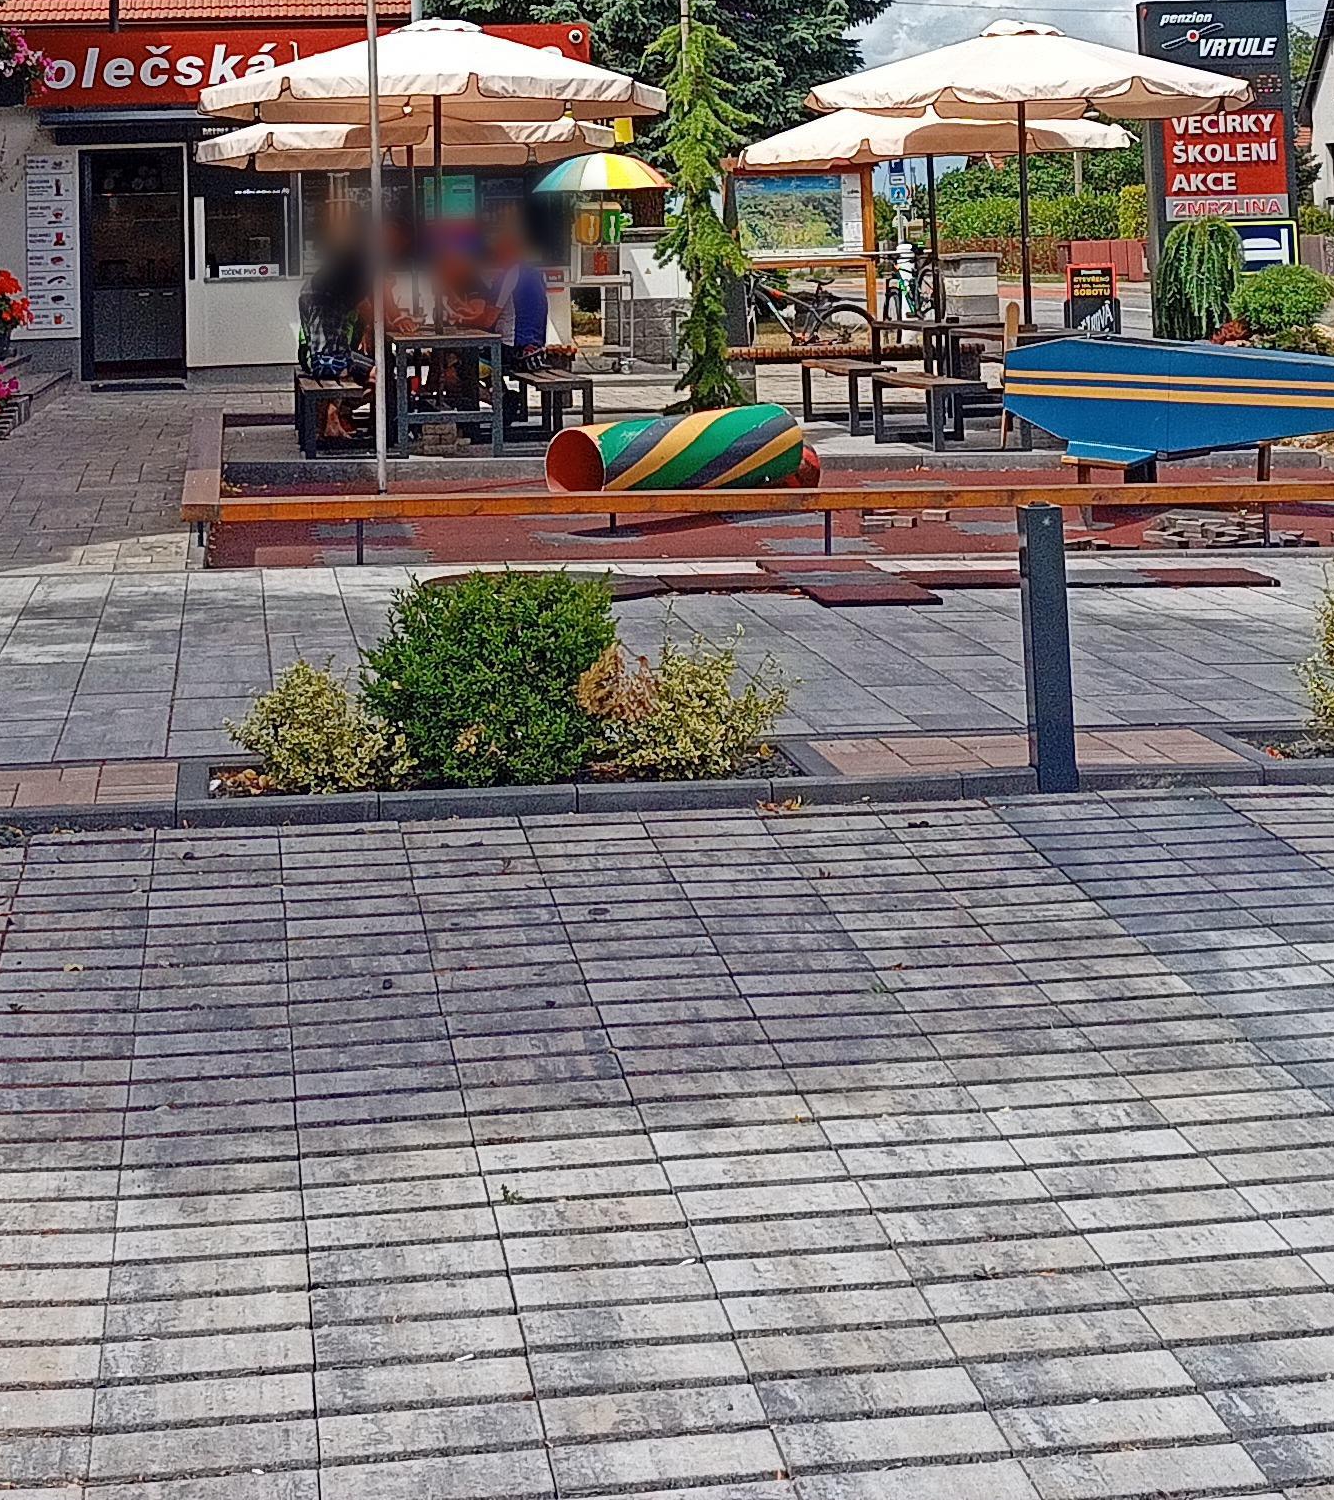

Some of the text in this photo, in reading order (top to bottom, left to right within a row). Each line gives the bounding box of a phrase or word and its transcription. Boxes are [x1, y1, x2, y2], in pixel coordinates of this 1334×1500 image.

[1159, 11, 1213, 27] penzion
[1199, 37, 1278, 58] VRTULE
[43, 43, 278, 89] olečská
[1172, 138, 1277, 164] ŠKOLENÍ
[1171, 172, 1237, 192] AKCE
[1172, 198, 1283, 217] ZMRZLINA
